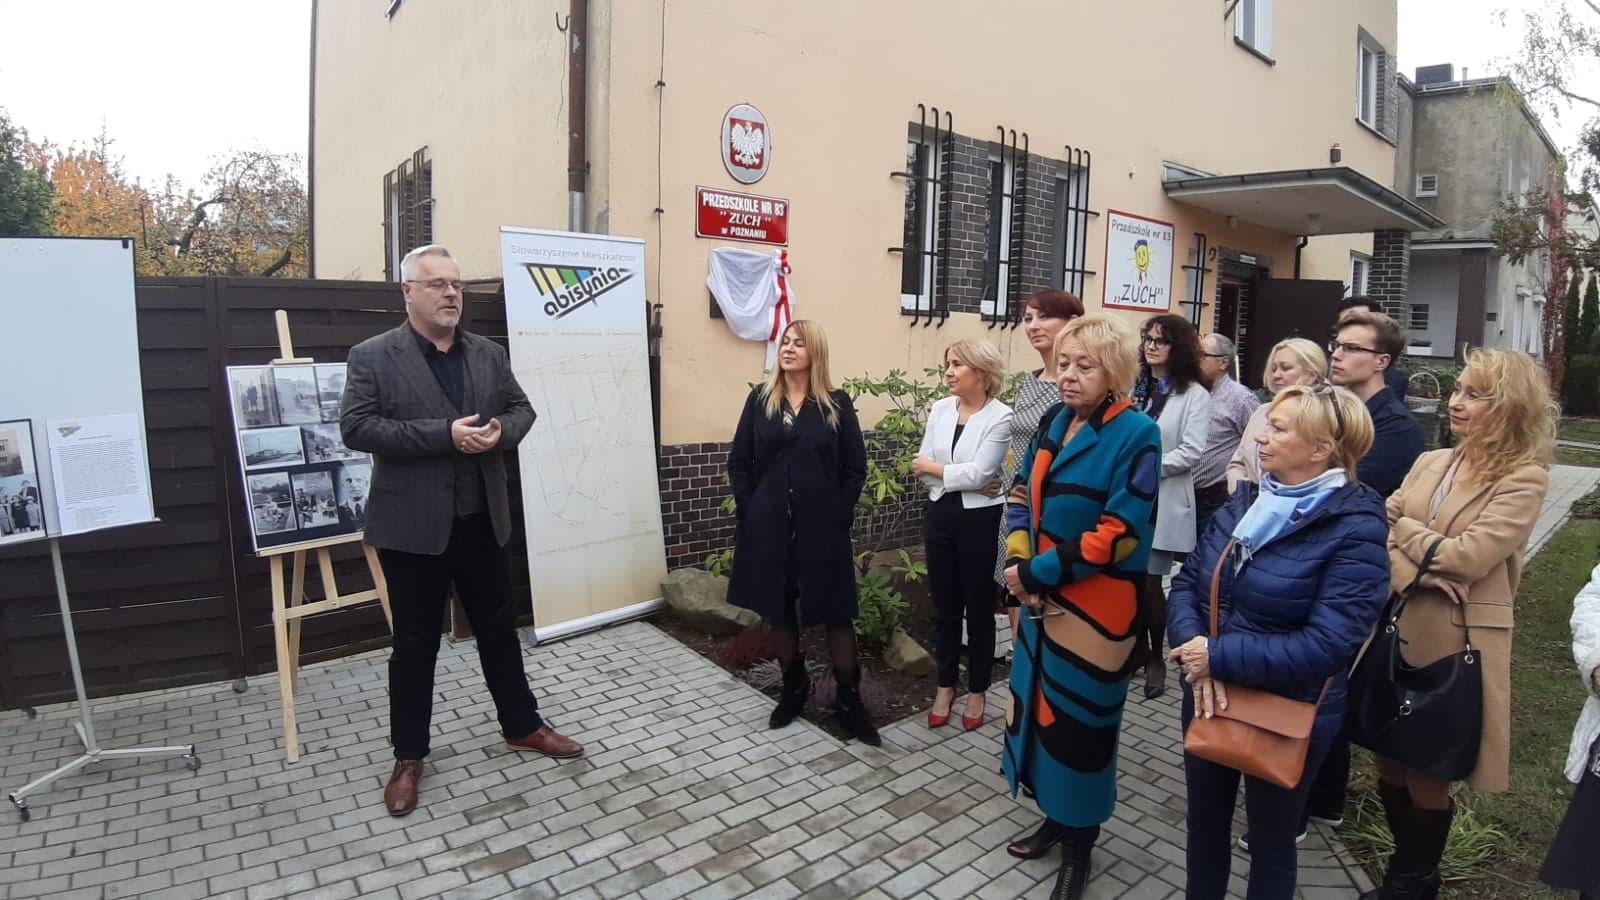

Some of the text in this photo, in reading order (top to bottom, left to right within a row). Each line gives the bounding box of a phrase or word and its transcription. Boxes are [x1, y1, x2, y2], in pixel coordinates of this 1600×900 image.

[702, 192, 784, 217] PRZEDSZKOLE NR 83
[730, 226, 767, 239] POZNANIU
[542, 265, 621, 317] abisynia
